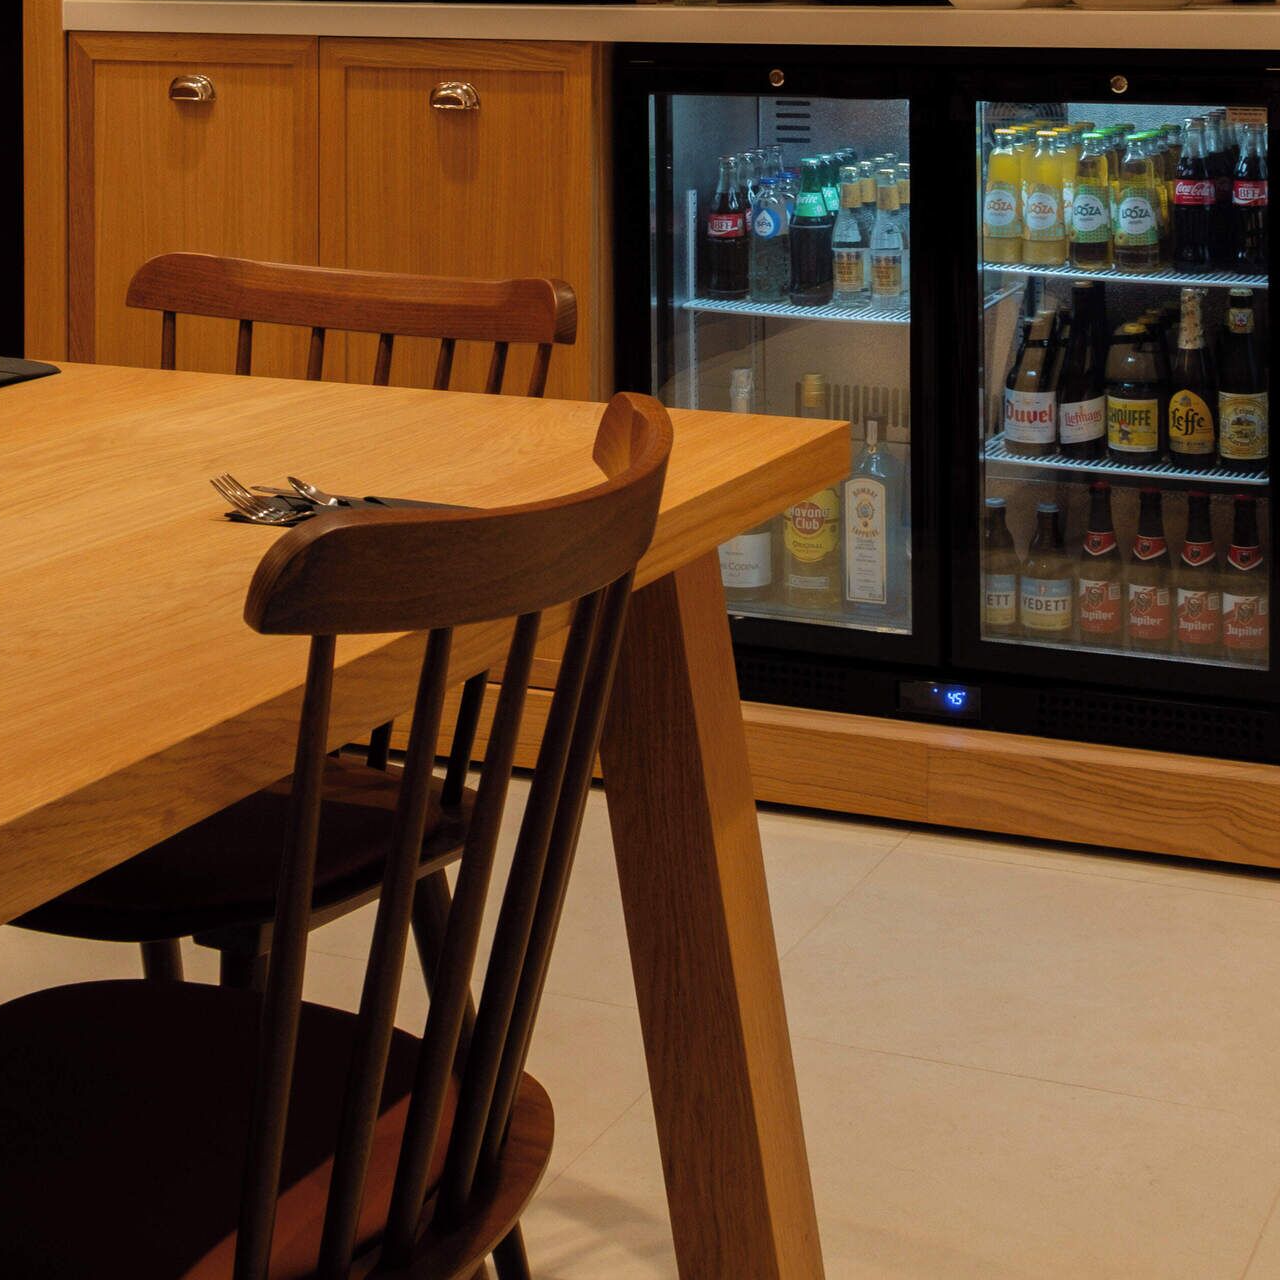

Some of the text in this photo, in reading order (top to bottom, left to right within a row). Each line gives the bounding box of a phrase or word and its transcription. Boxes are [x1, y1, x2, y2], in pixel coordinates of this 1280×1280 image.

[1176, 182, 1216, 196] Coca-Cola
[757, 220, 772, 229] SPA
[1006, 401, 1052, 424] Duvel
[1171, 408, 1205, 436] Leffe
[795, 518, 820, 530] Club
[1130, 614, 1163, 626] Jupiler
[1179, 618, 1214, 631] Jupiler
[1227, 624, 1263, 637] Jupiler
